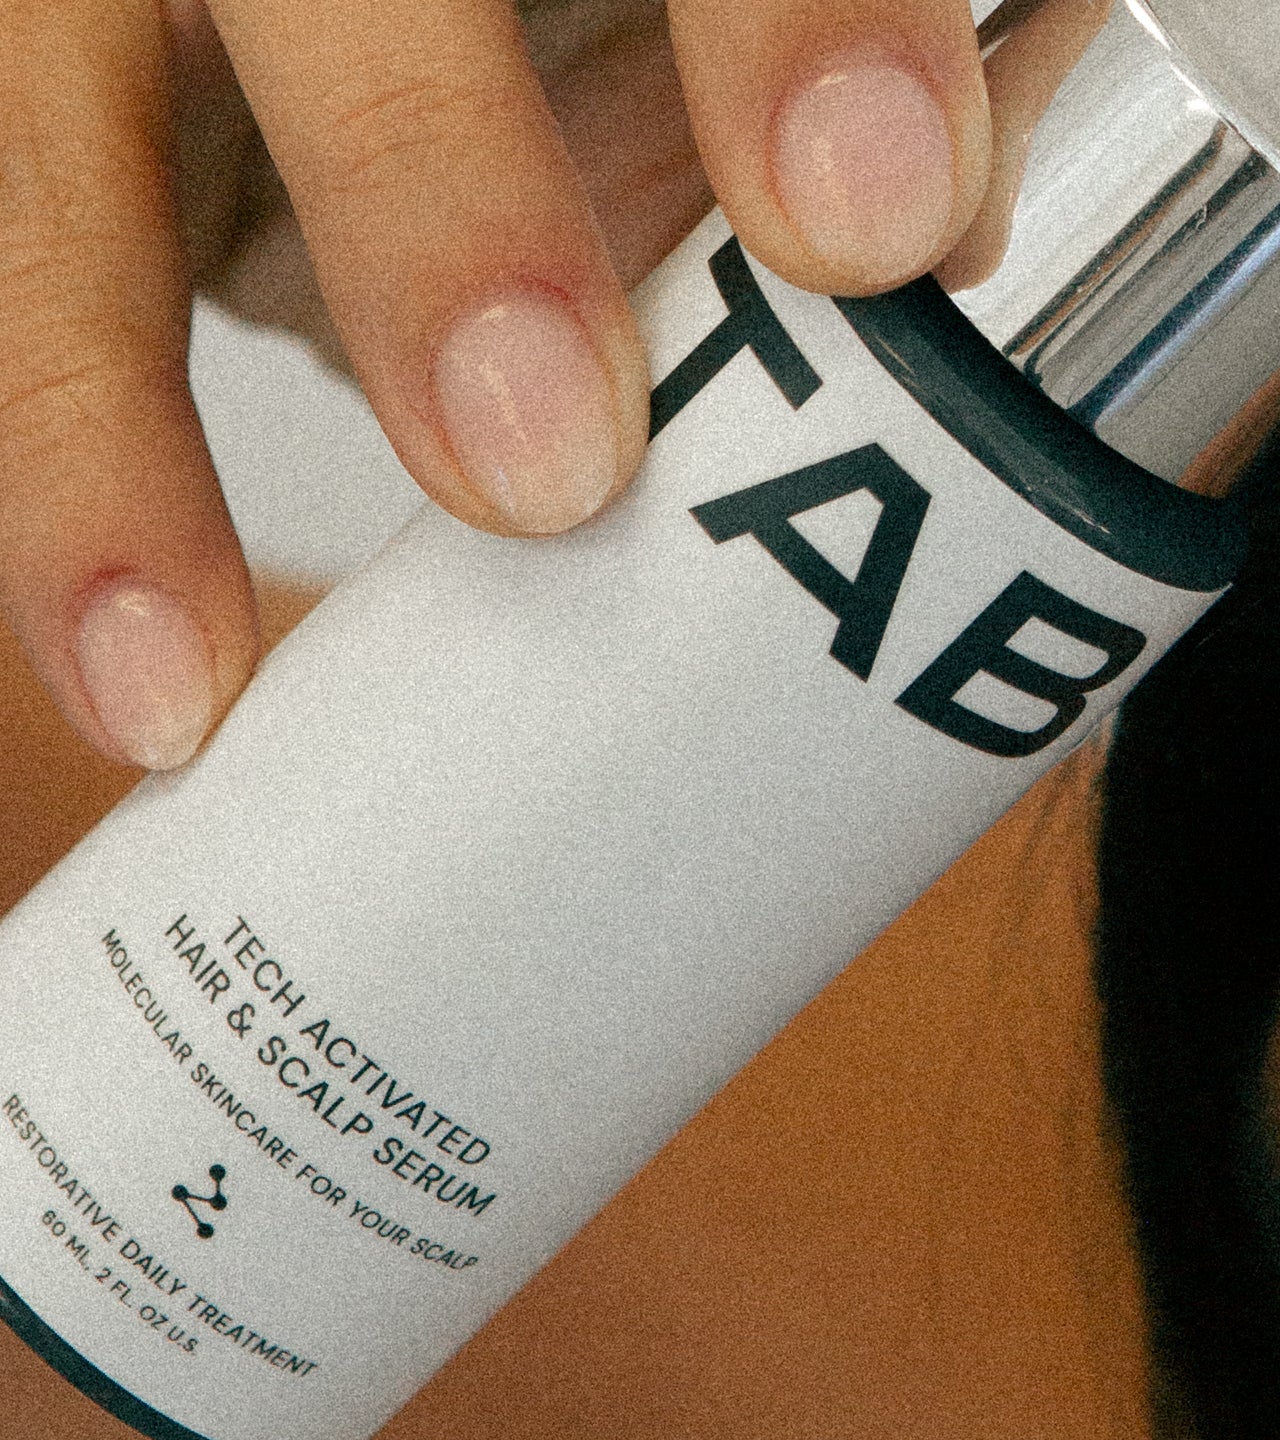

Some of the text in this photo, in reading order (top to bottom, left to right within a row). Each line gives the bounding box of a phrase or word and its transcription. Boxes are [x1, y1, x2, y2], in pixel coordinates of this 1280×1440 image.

[649, 234, 1148, 759] TAB
[101, 928, 479, 1269] MOLECULAR SKINCARE FOR YOUR SCALP
[165, 914, 497, 1217] HAIR & SCALP SERUM
[223, 915, 491, 1164] TECH ACTIVATED
[3, 1094, 319, 1376] RESTORATIVE DAILY TREATMENT
[42, 1210, 66, 1236] 60
[94, 1267, 112, 1283] 2
[139, 1305, 169, 1331] OZ
